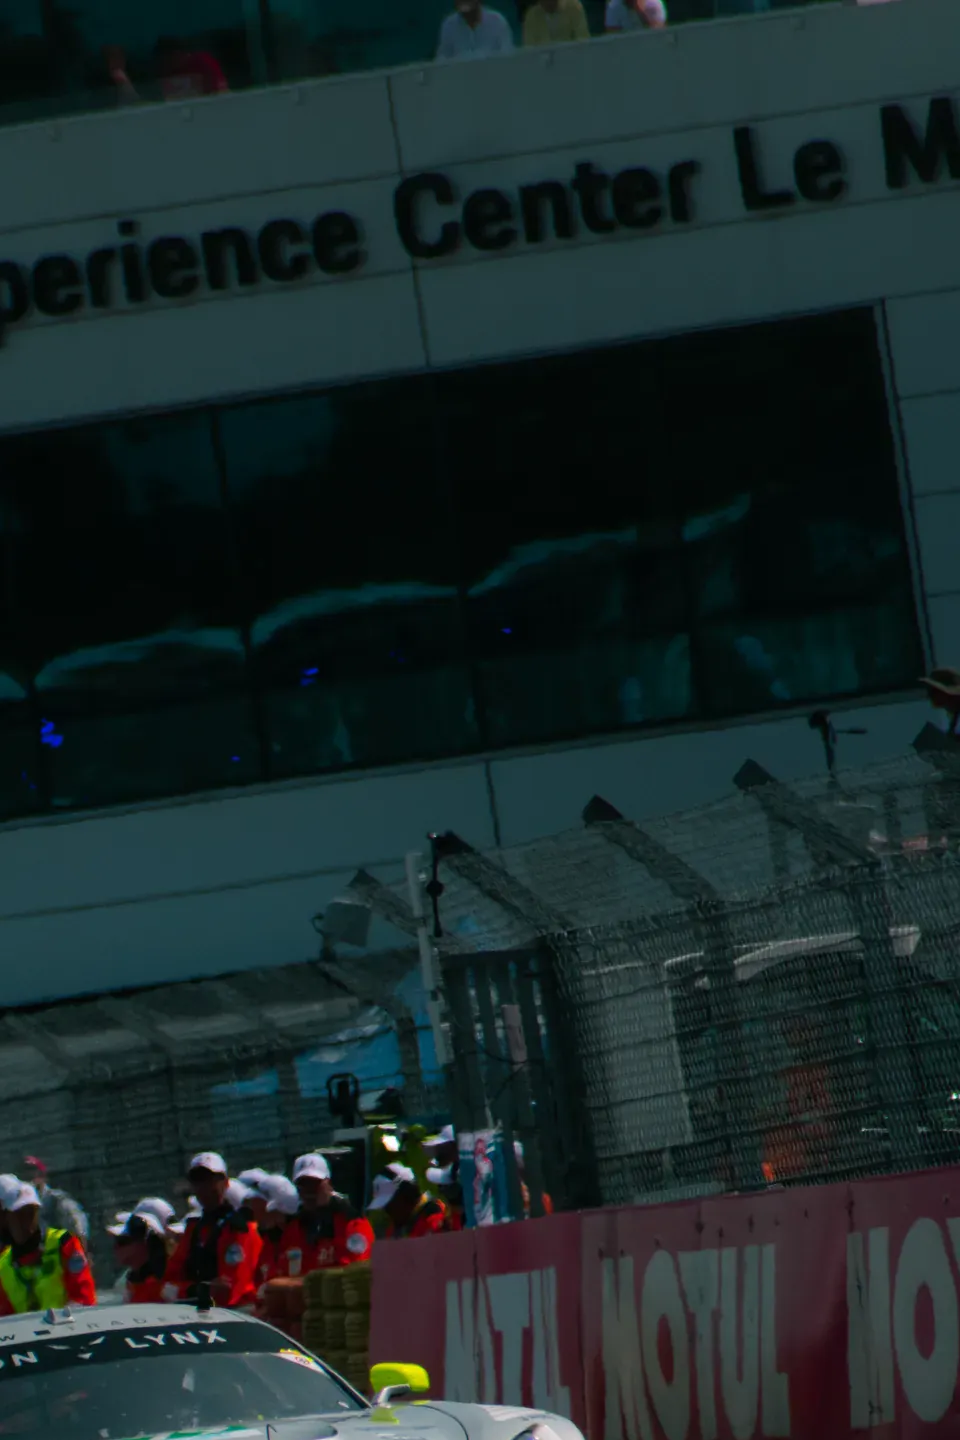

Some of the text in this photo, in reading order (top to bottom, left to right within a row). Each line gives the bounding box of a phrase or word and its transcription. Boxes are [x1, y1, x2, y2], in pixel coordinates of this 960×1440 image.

[394, 162, 700, 260] Center
[734, 126, 848, 212] Le
[125, 1328, 228, 1349] LYNX
[846, 1216, 960, 1430] MO
